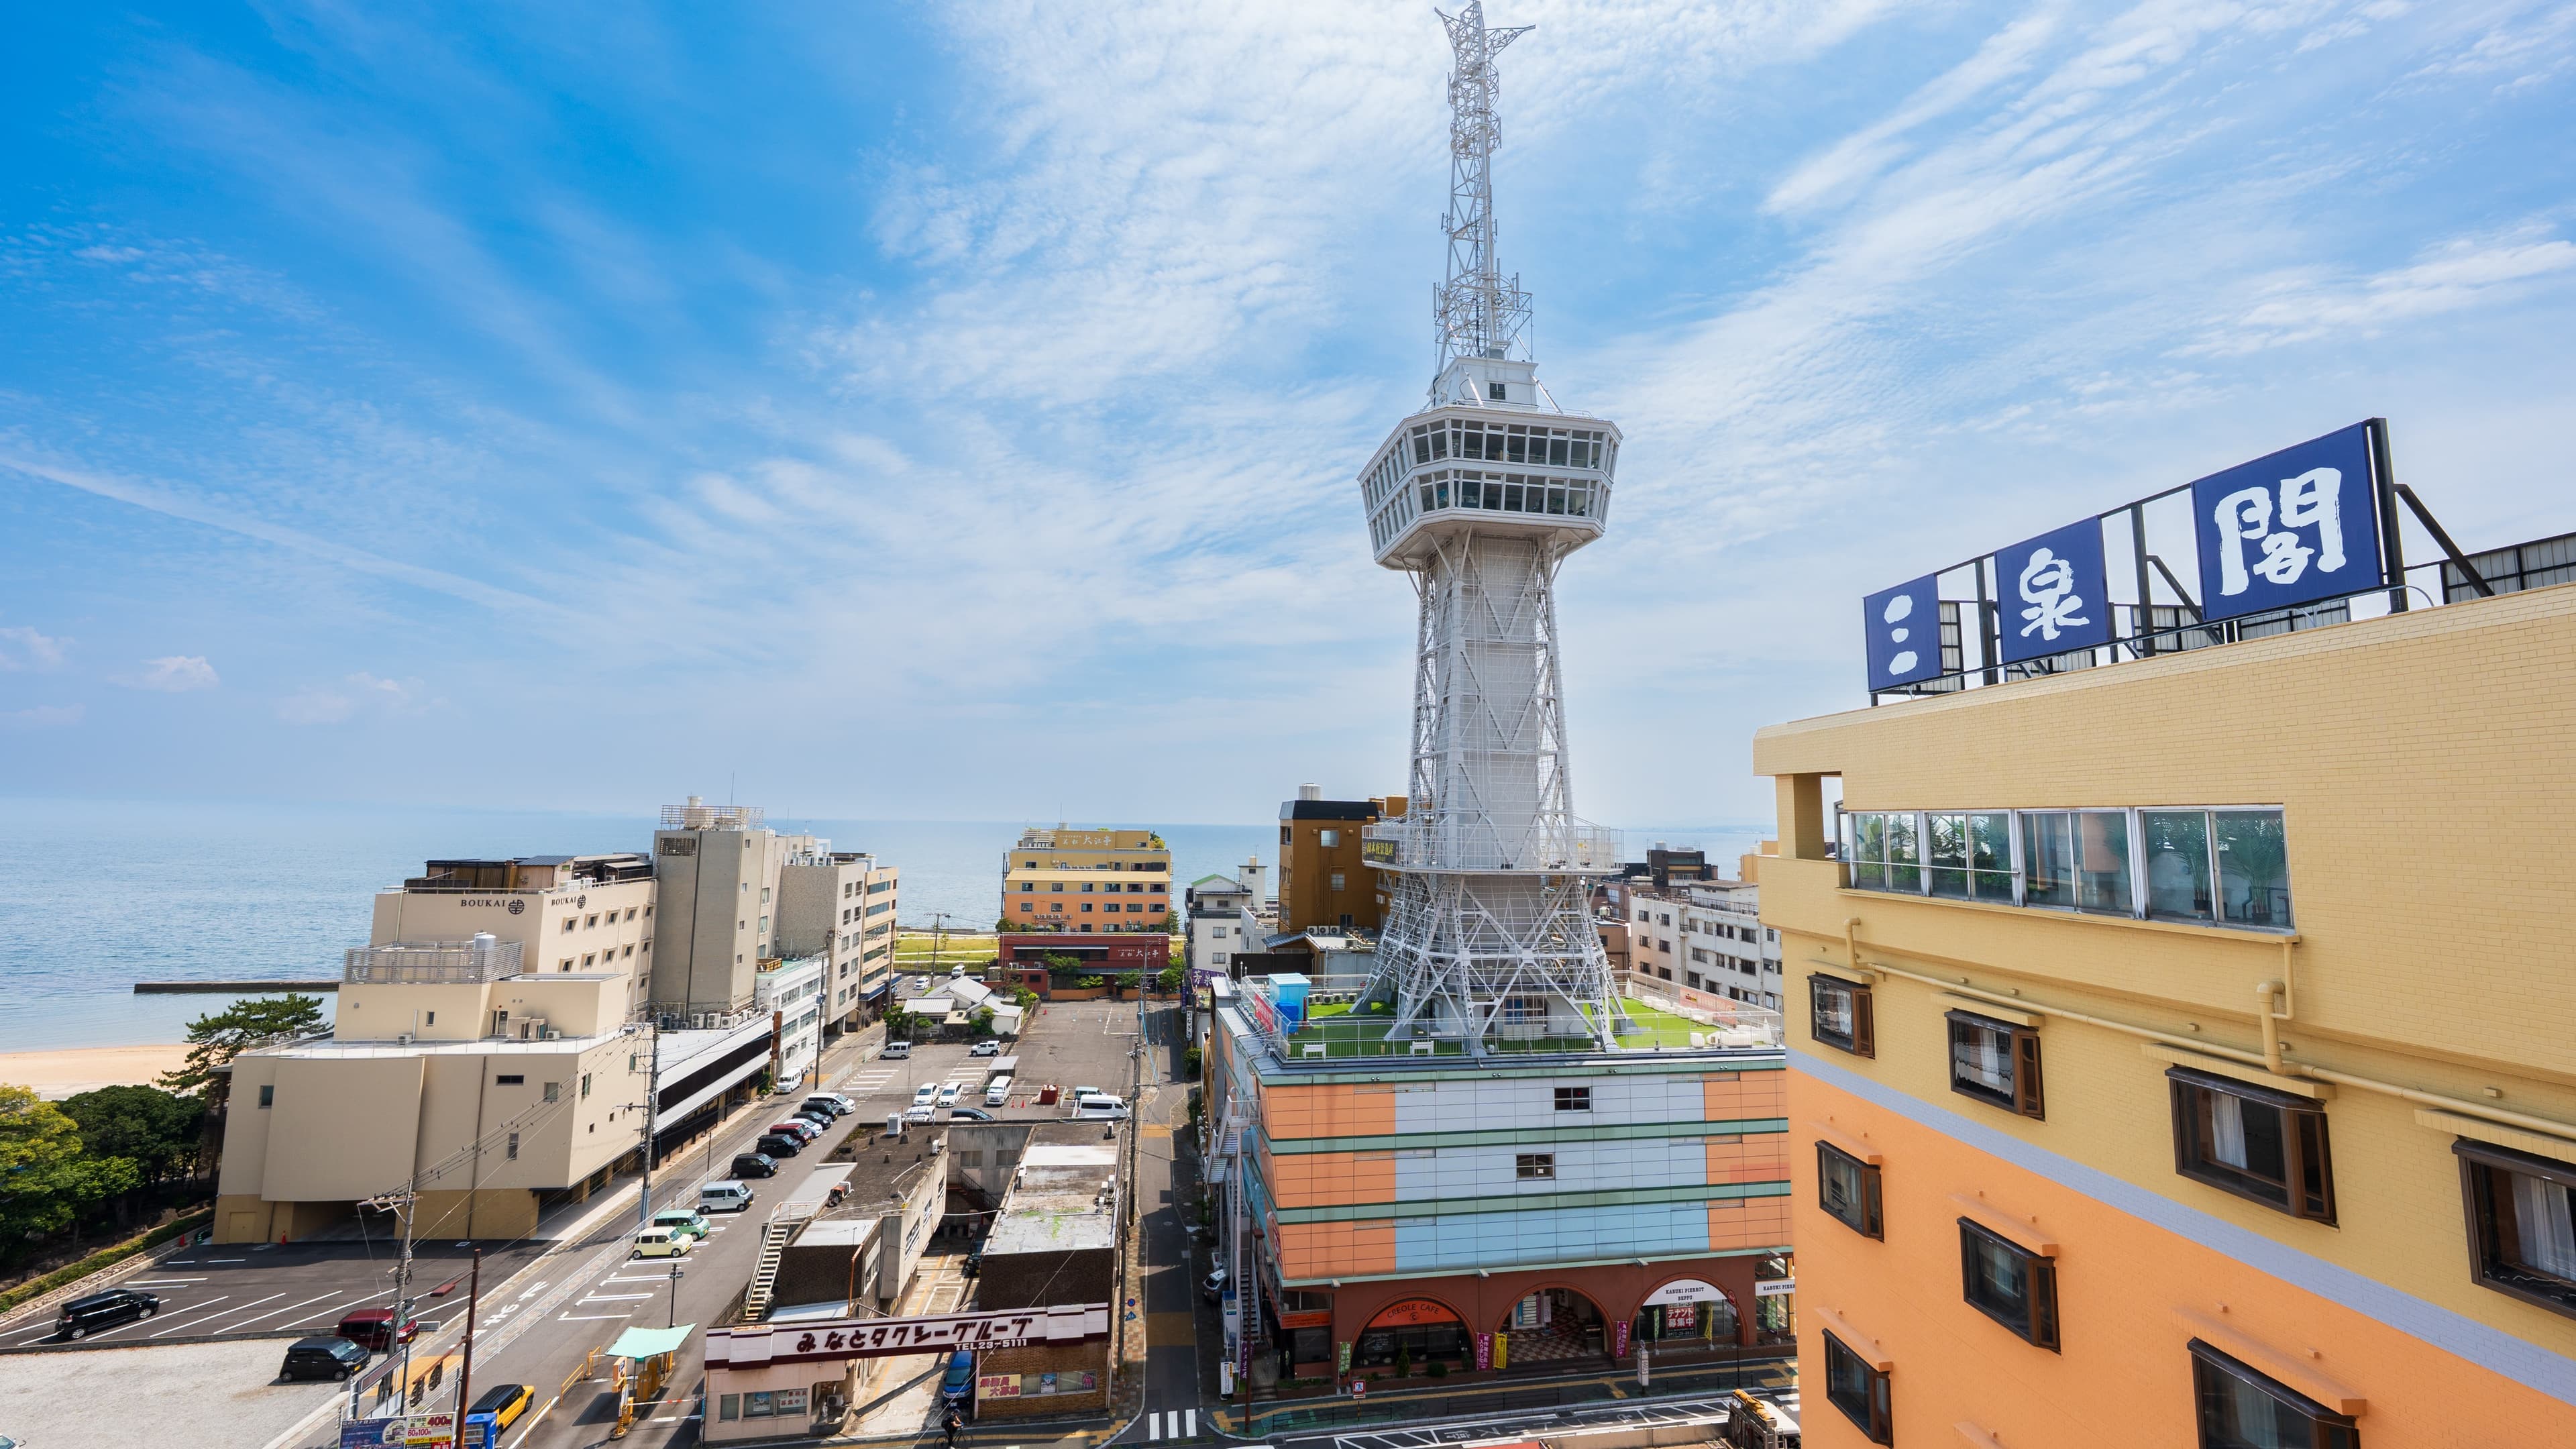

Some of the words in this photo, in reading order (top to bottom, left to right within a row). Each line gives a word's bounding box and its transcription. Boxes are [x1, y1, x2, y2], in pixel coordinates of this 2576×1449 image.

[1083, 835, 1112, 846] 大江亭
[460, 899, 506, 907] BOUKAI
[551, 896, 576, 906] BOUKAI
[1387, 1303, 1417, 1318] CREOLE
[1420, 1303, 1440, 1315] CAFE
[1668, 1307, 1693, 1318] テナント
[1668, 1317, 1694, 1328] 募集中
[796, 1318, 1034, 1353] みなとタクシーグループ
[988, 1385, 1020, 1397] 大募集
